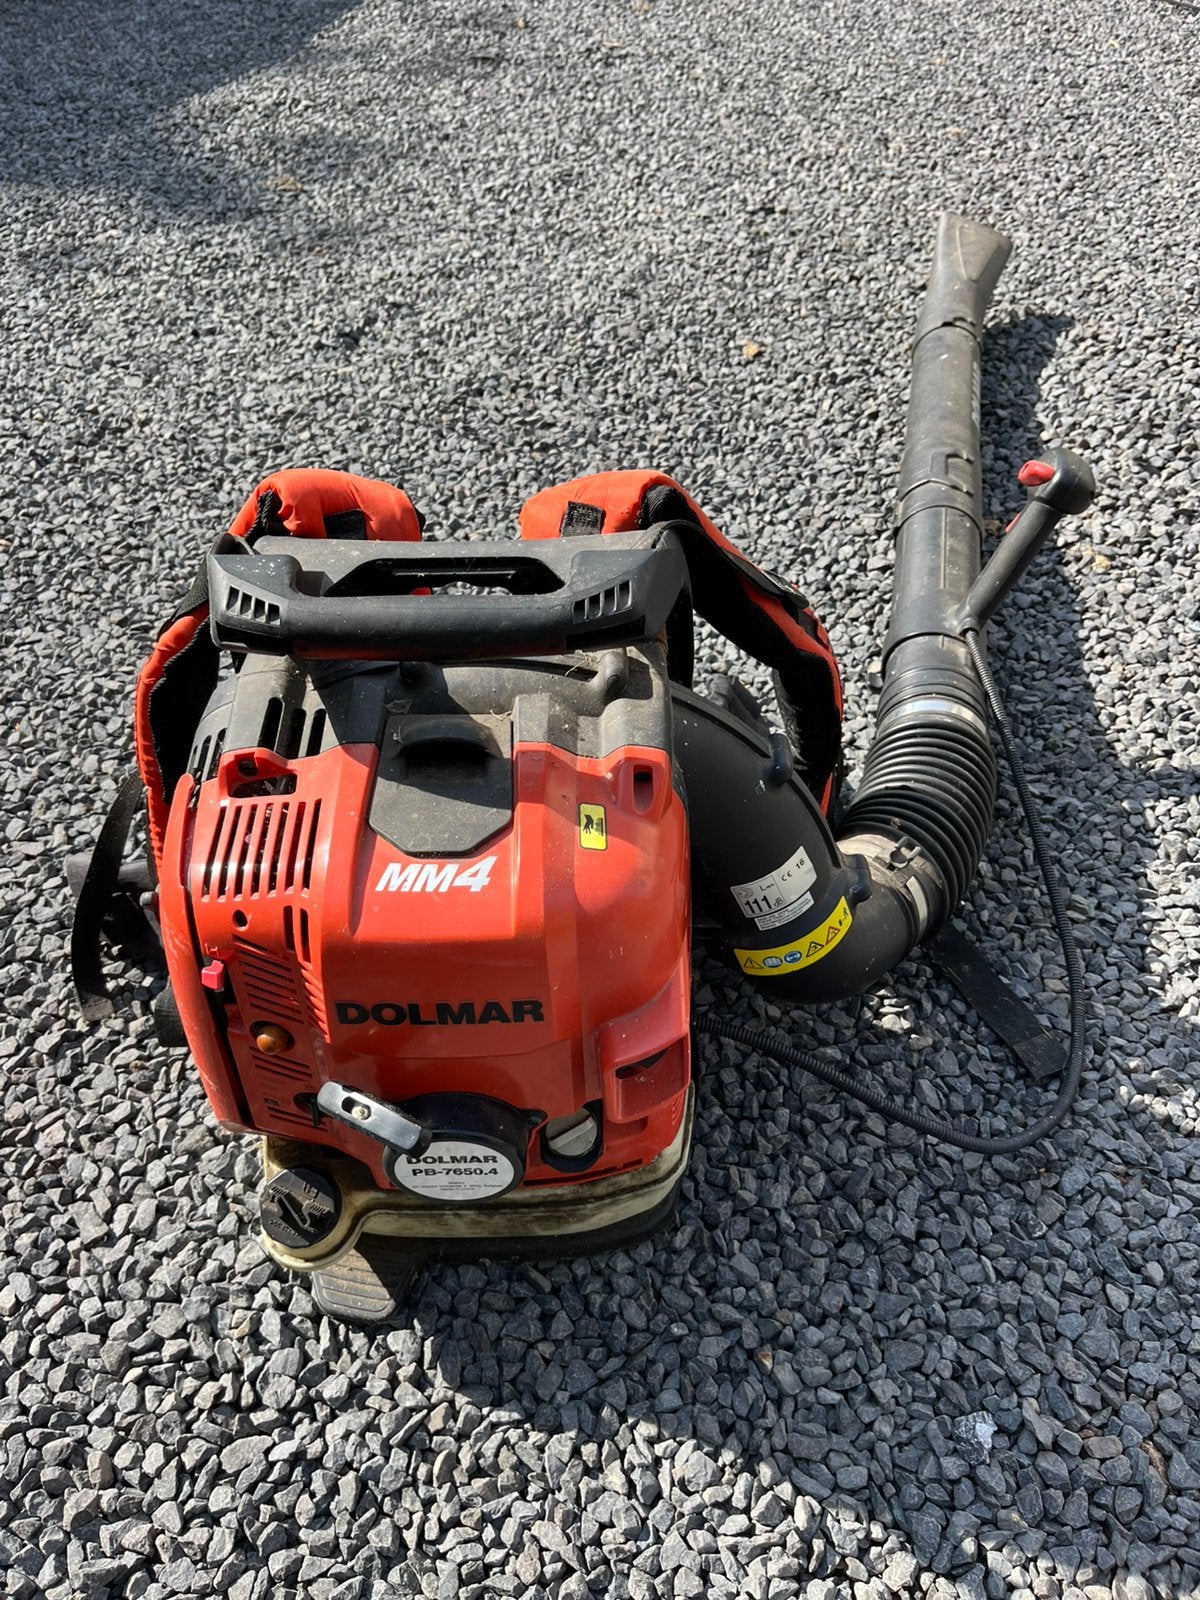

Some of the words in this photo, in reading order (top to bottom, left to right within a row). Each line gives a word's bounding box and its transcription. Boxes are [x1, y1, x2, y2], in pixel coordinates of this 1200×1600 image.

[795, 858, 805, 869] 16
[375, 856, 498, 892] MM4
[744, 895, 773, 914] 111
[774, 897, 784, 907] dB
[335, 1000, 544, 1025] DOLMAR
[412, 1168, 499, 1176] PB-7650.4
